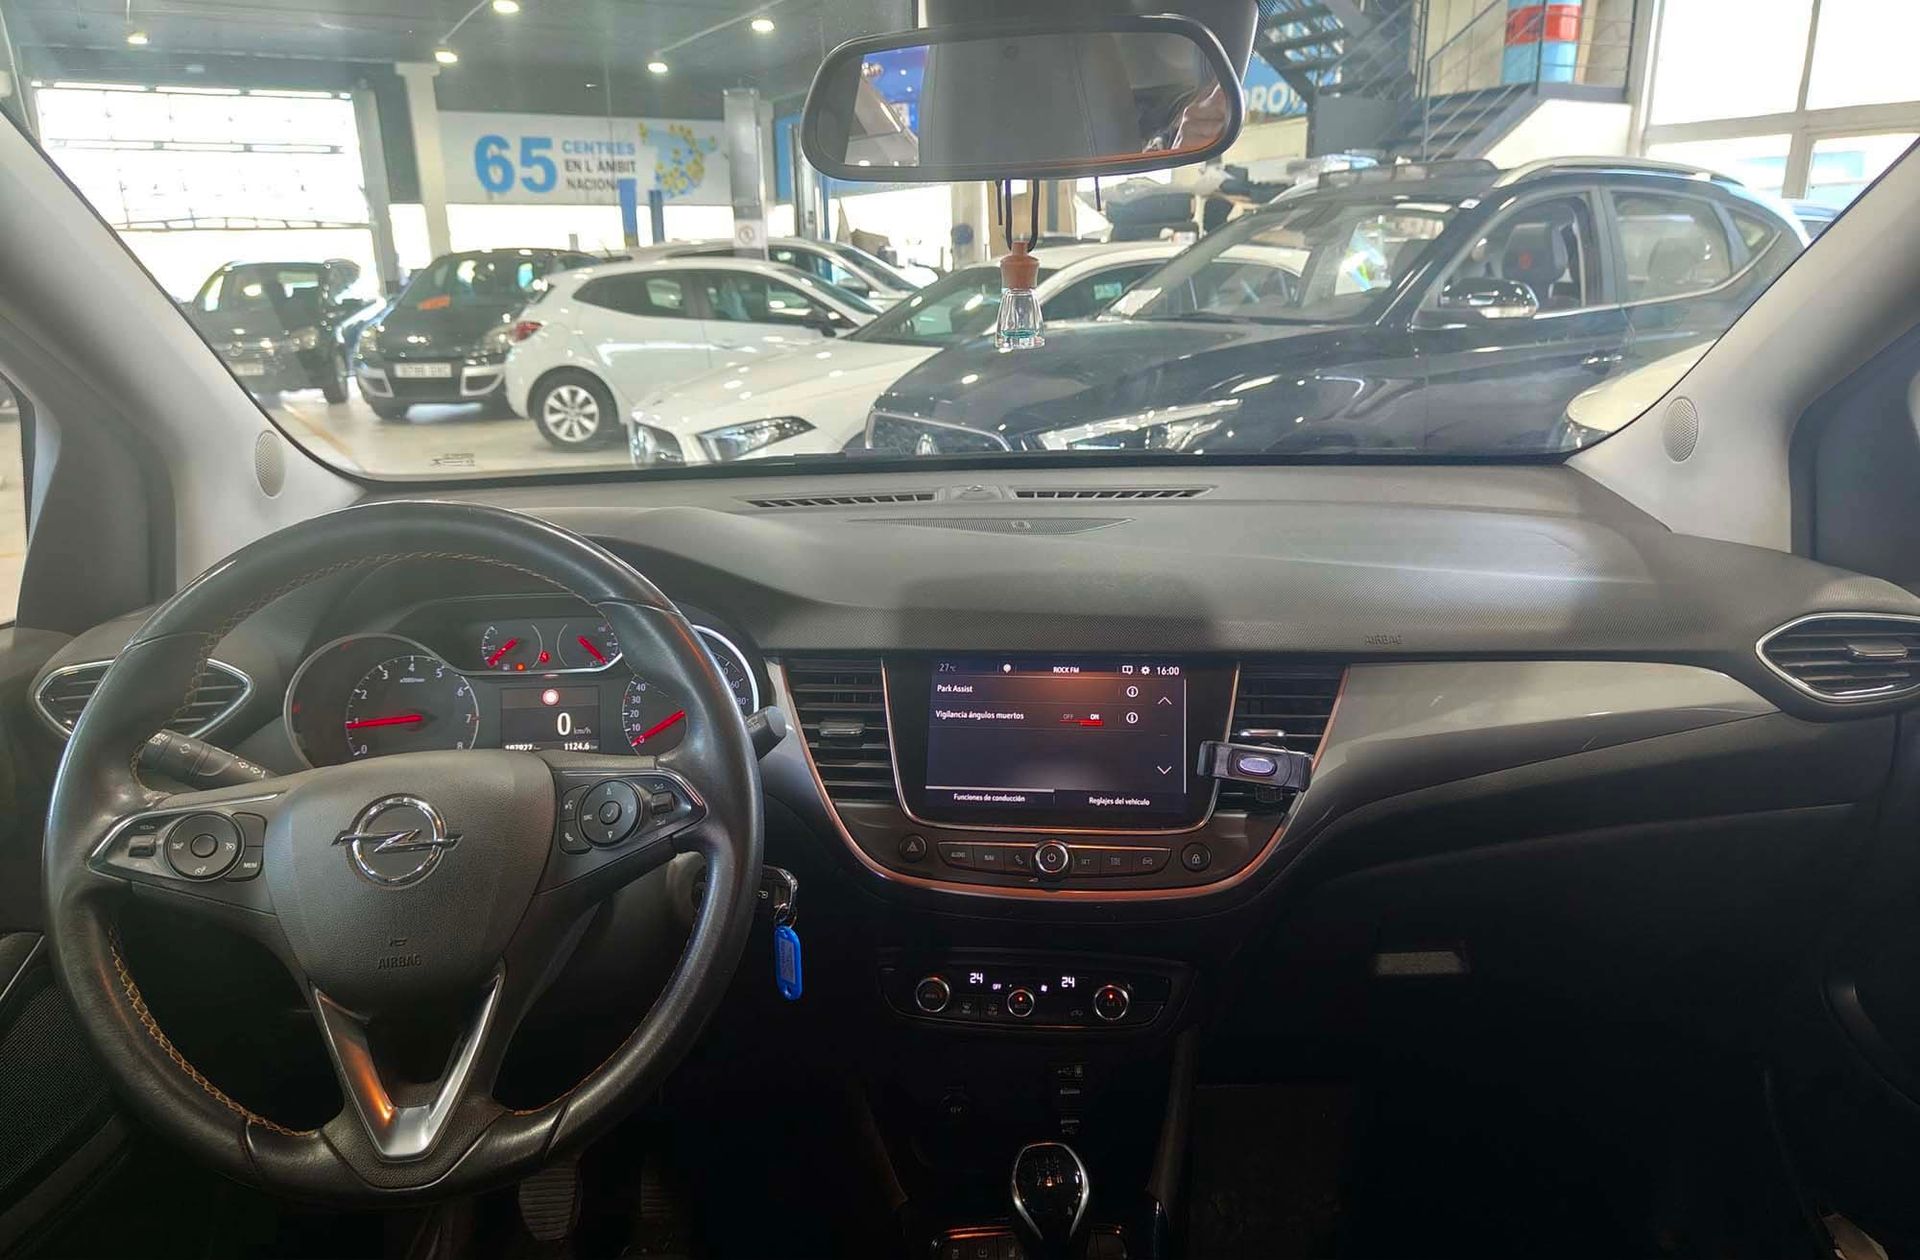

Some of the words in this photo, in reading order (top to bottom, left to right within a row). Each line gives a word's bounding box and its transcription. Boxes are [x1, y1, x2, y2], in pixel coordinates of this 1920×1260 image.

[561, 140, 635, 156] CENTRES
[475, 134, 557, 193] 65
[565, 159, 582, 172] EN
[566, 178, 617, 191] NACION
[408, 663, 415, 672] 4
[1157, 666, 1180, 676] 16:00
[382, 671, 389, 680] 3
[436, 668, 442, 678] 5
[457, 687, 464, 697] 6
[636, 684, 646, 692] 40
[937, 684, 952, 692] Park
[953, 685, 973, 693] Assist
[361, 690, 367, 699] 2
[632, 695, 641, 704] 30
[465, 714, 471, 723] 7
[630, 710, 639, 718] 20
[935, 709, 967, 719] Vigilancia
[969, 710, 995, 720] ángulos
[996, 712, 1024, 720] muertos
[557, 713, 571, 735] 0
[574, 727, 591, 736] km/h
[632, 723, 641, 731] 10
[360, 745, 367, 754] 0
[564, 742, 590, 750] 1124.6
[953, 793, 983, 801] Funciones
[992, 794, 1026, 802] conducción
[1088, 796, 1113, 806] Reglajes
[1115, 797, 1124, 805] del
[1125, 798, 1150, 806] vehículo
[378, 956, 422, 970] AIRBAG
[969, 973, 983, 983] 24
[1061, 976, 1076, 988] 24
